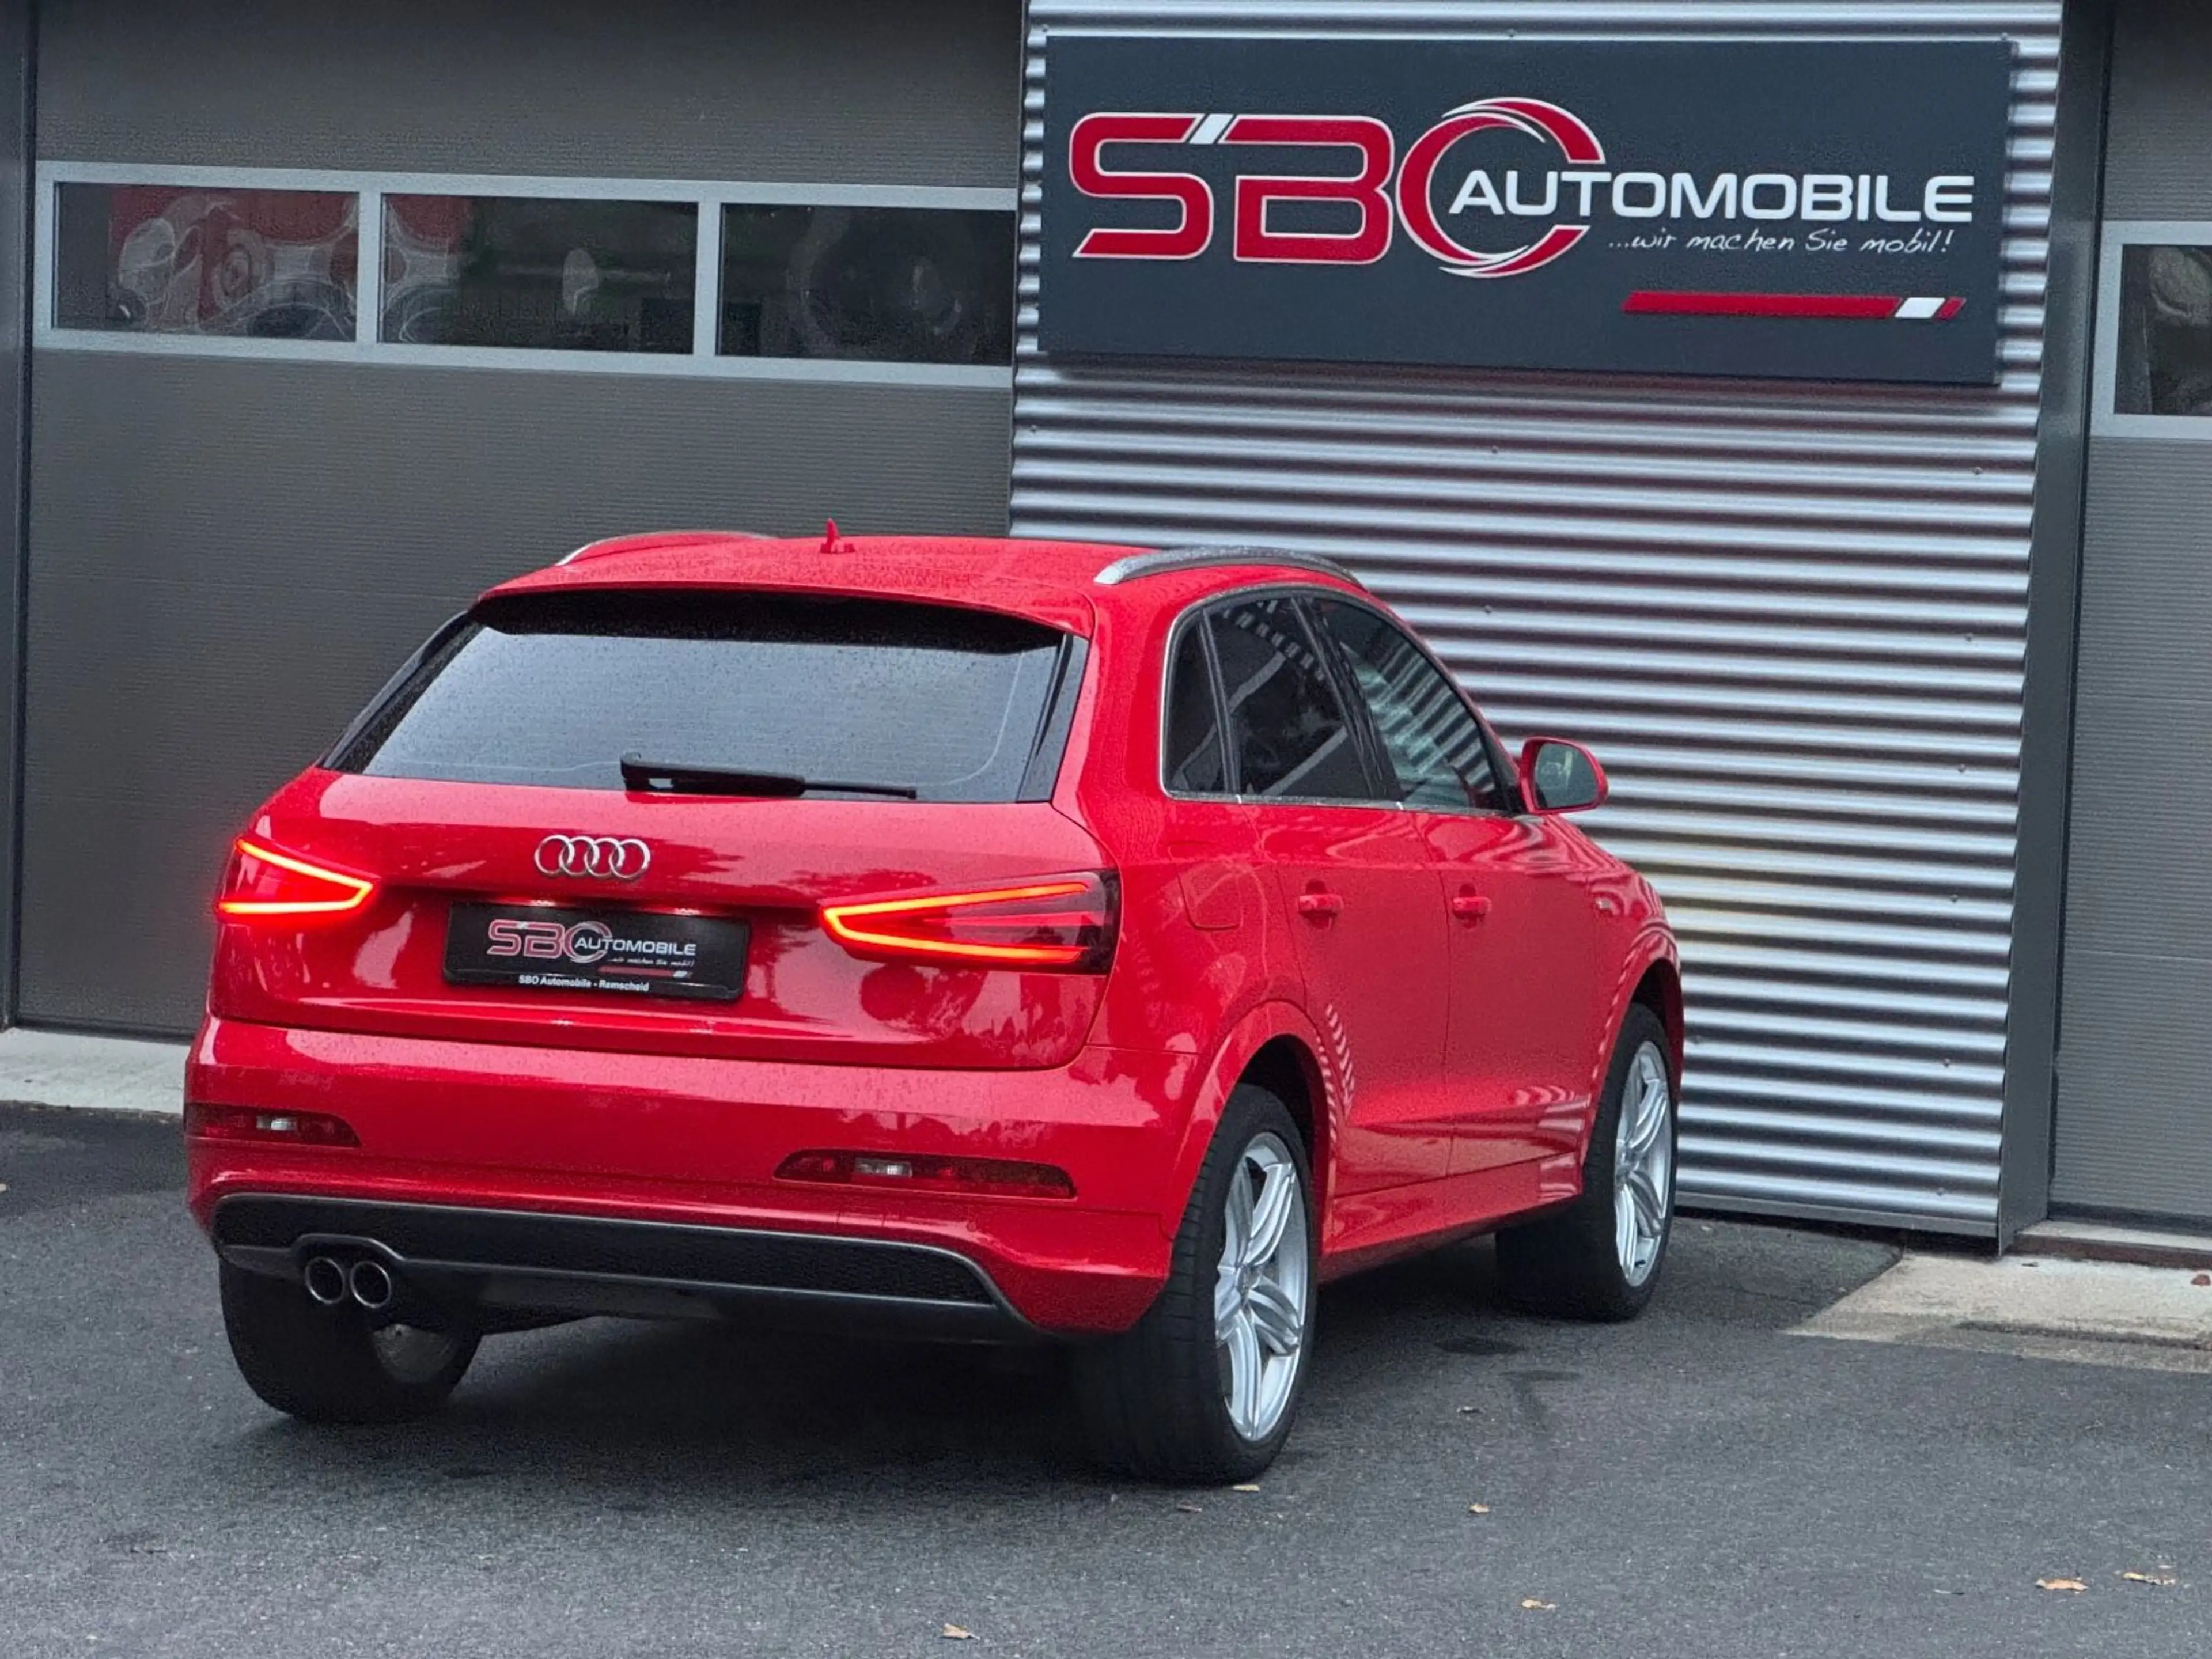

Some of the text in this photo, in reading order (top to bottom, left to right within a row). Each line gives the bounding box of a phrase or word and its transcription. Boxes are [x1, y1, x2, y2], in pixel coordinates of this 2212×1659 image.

[1449, 169, 1975, 223] AUTOMOBILE
[1685, 228, 1796, 252] machen
[1805, 228, 1848, 251] Sie
[1859, 227, 1955, 254] mobil!
[574, 935, 696, 957] AUTOMOBILE
[518, 974, 539, 985] SBO
[540, 976, 592, 988] Automobile
